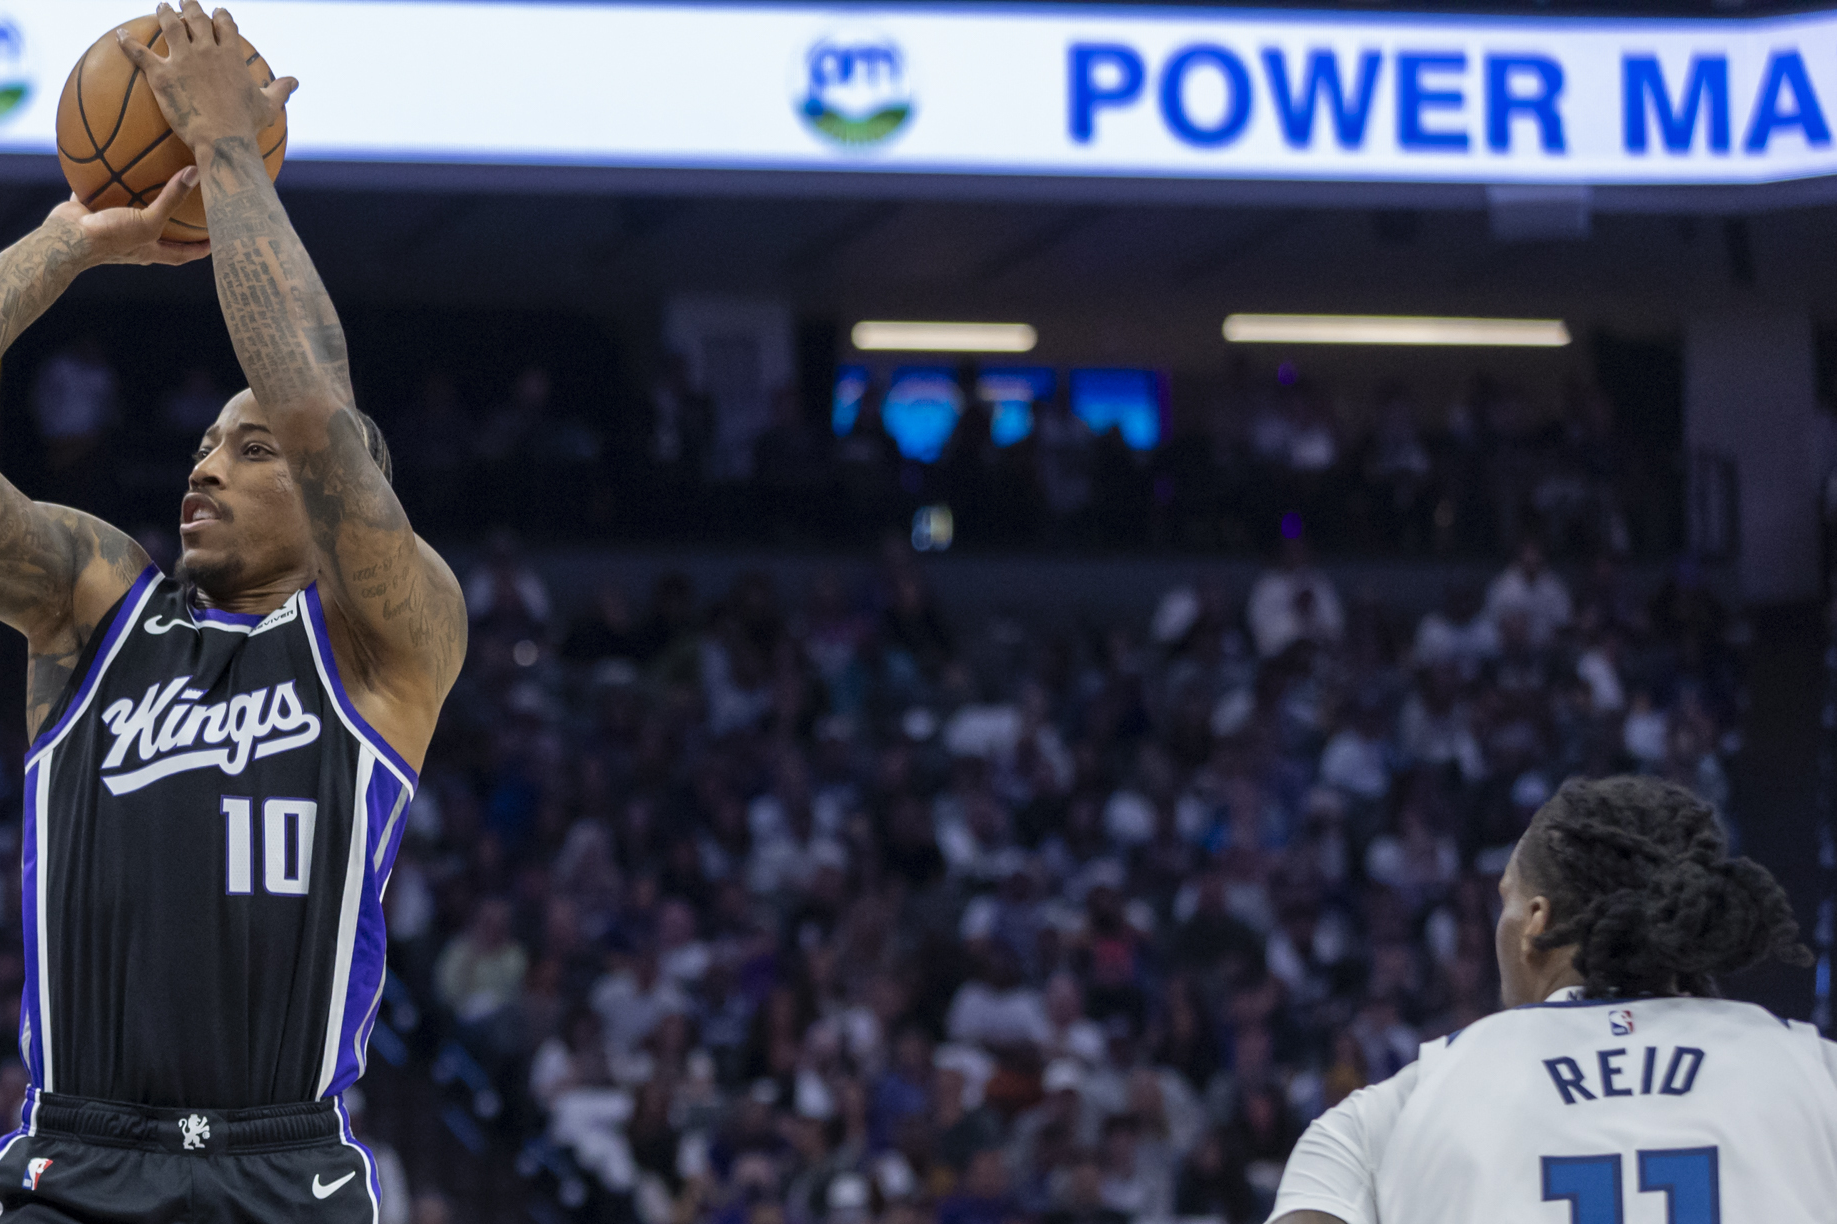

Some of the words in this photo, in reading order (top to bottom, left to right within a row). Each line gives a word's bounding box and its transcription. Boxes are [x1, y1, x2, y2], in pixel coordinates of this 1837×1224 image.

[1066, 40, 1572, 155] POWER
[1620, 46, 1832, 156] MA
[100, 674, 321, 796] Kings
[220, 794, 318, 896] 10
[1542, 1045, 1706, 1105] REID
